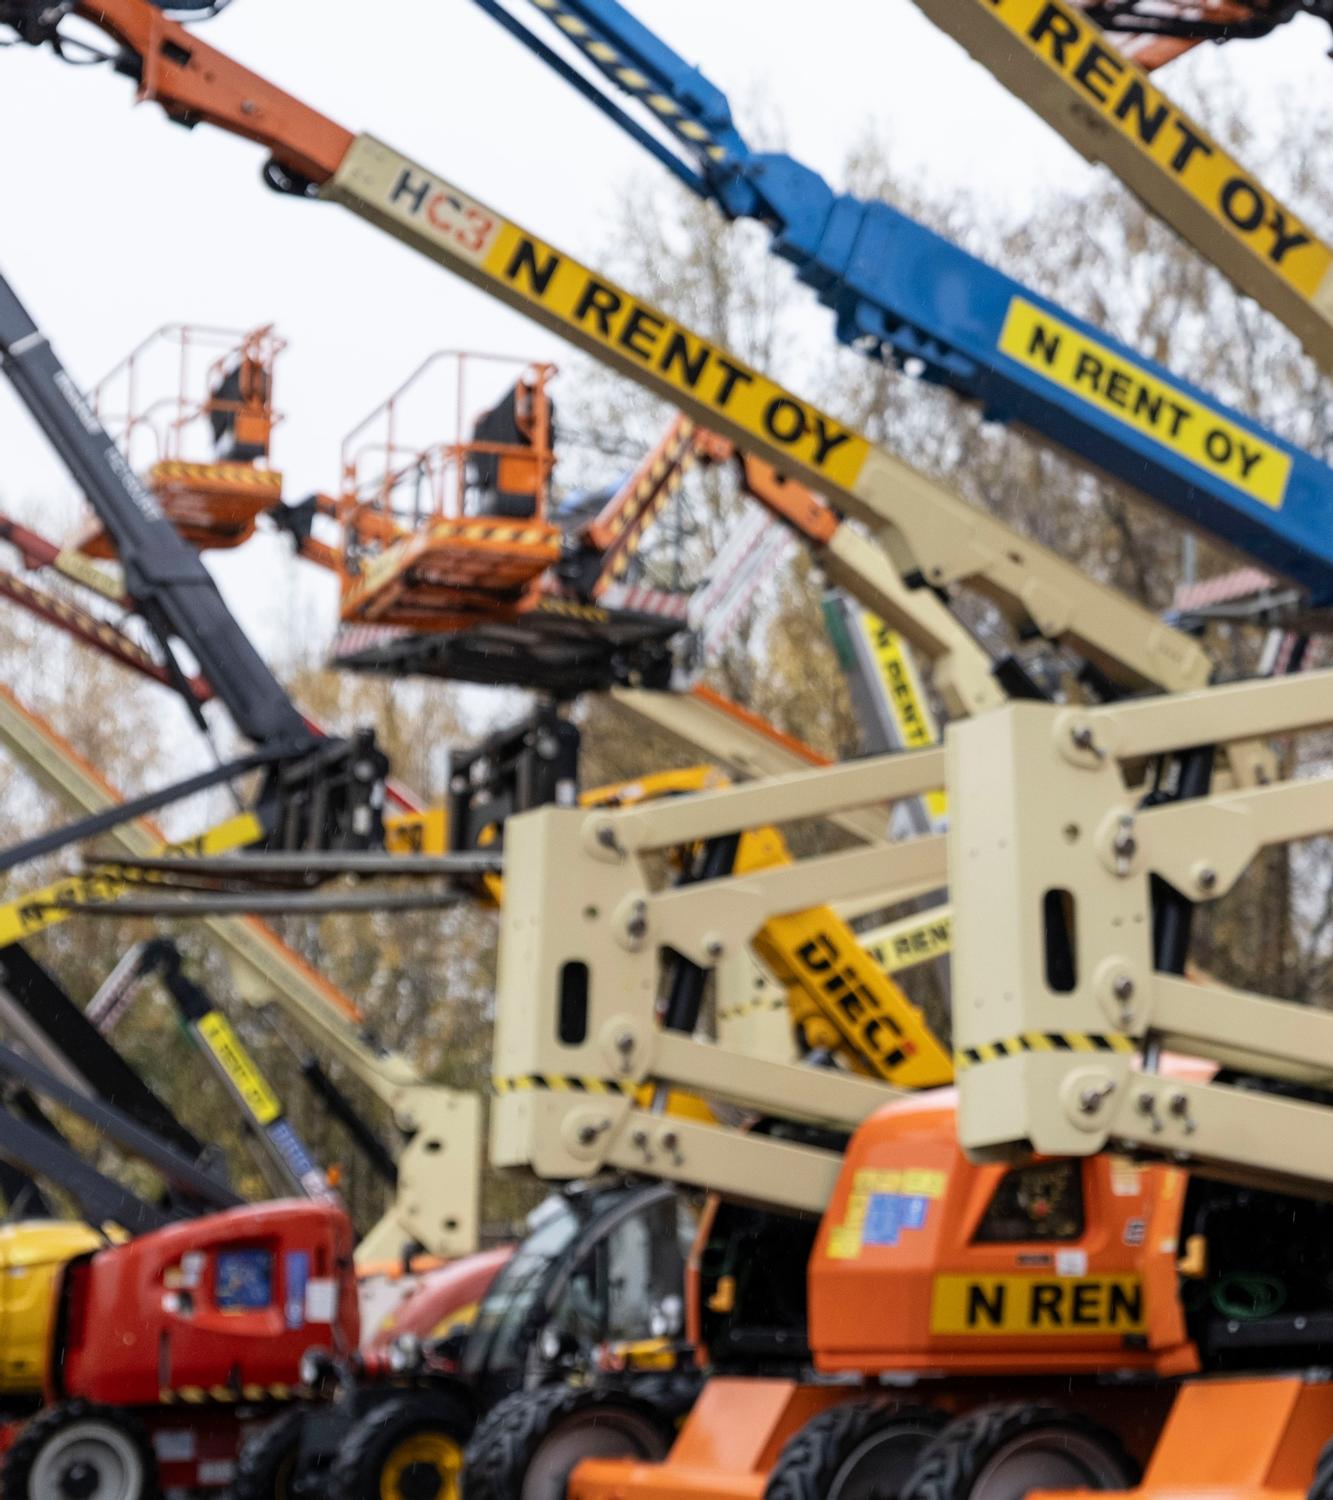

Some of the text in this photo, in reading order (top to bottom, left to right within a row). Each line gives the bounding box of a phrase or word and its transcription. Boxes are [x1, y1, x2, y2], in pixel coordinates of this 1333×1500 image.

[1028, 3, 1312, 264] RENT OY
[506, 239, 560, 296] N
[575, 280, 753, 406] RENT
[760, 396, 854, 466] OY
[1028, 324, 1262, 480] N RENT OY
[966, 1282, 1143, 1328] N REN
